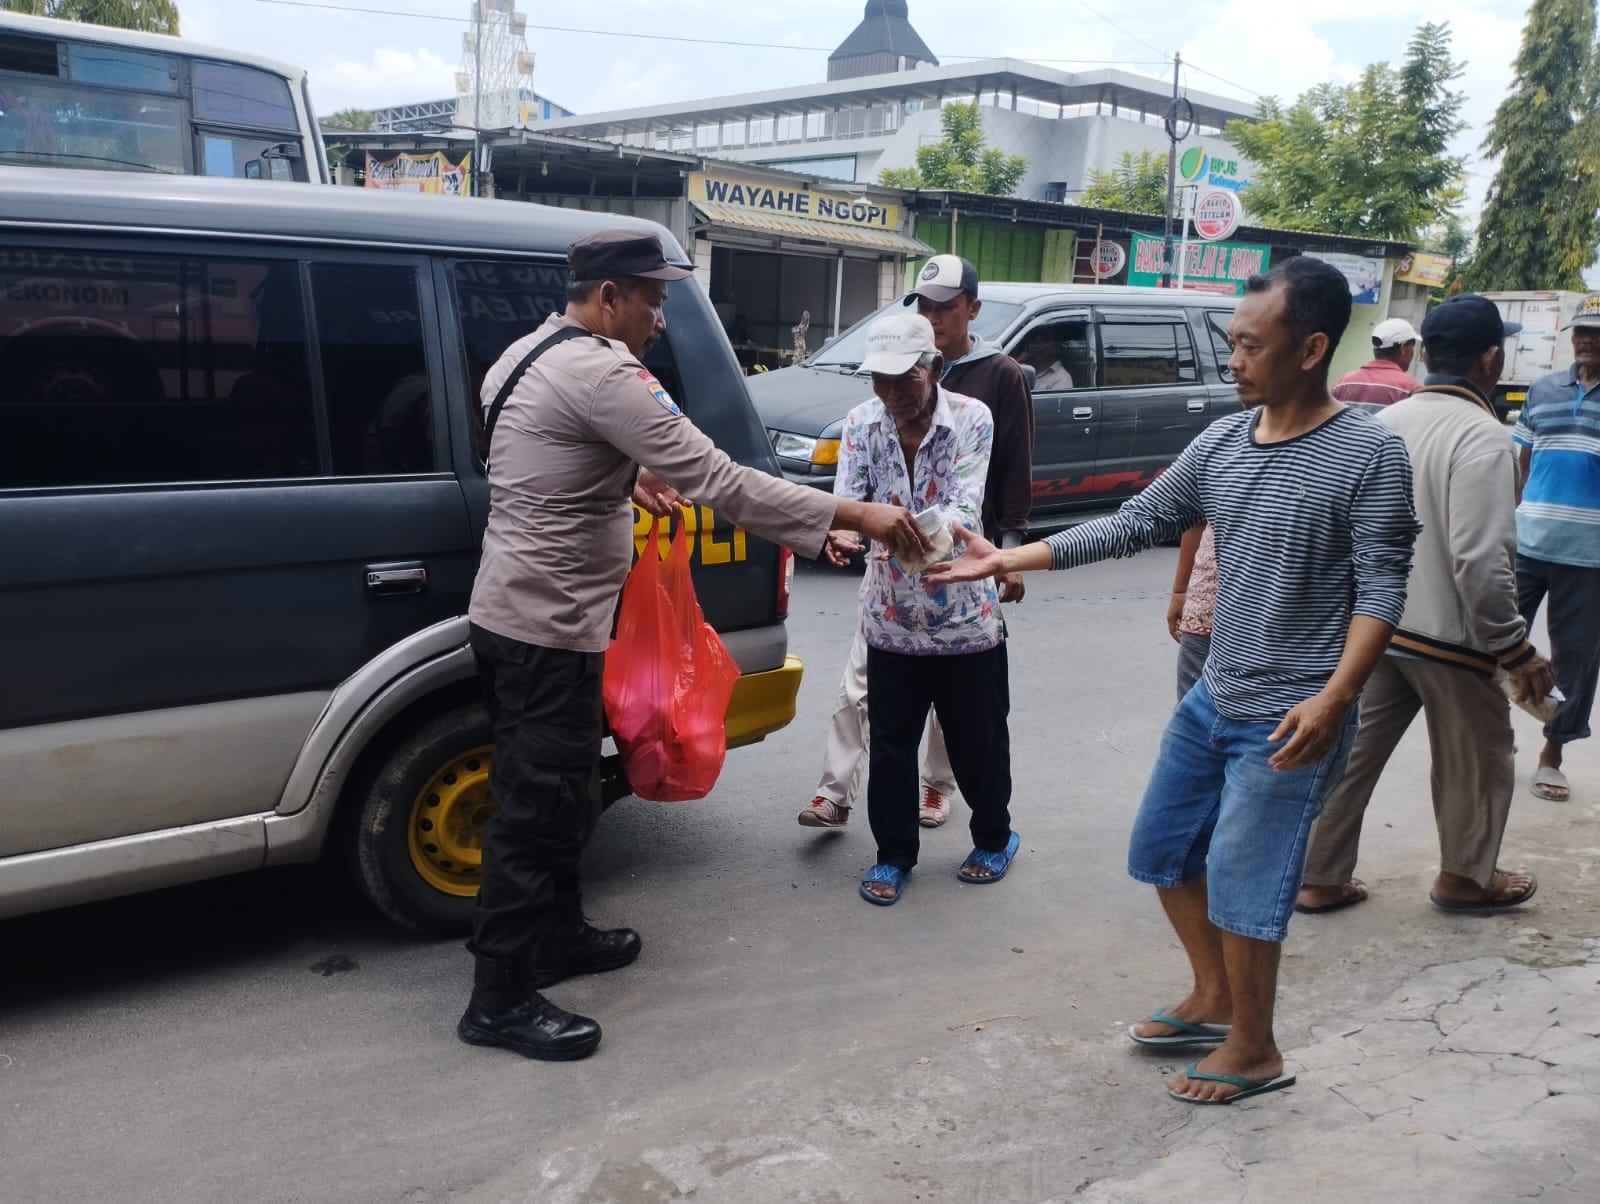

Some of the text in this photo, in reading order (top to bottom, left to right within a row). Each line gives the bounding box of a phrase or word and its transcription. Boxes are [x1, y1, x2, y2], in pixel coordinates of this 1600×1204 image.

[1210, 156, 1238, 177] BPJS
[705, 179, 888, 226] WAYAHE NGOPI
[1134, 238, 1170, 274] BAKS
[1171, 242, 1217, 278] TTELAN
